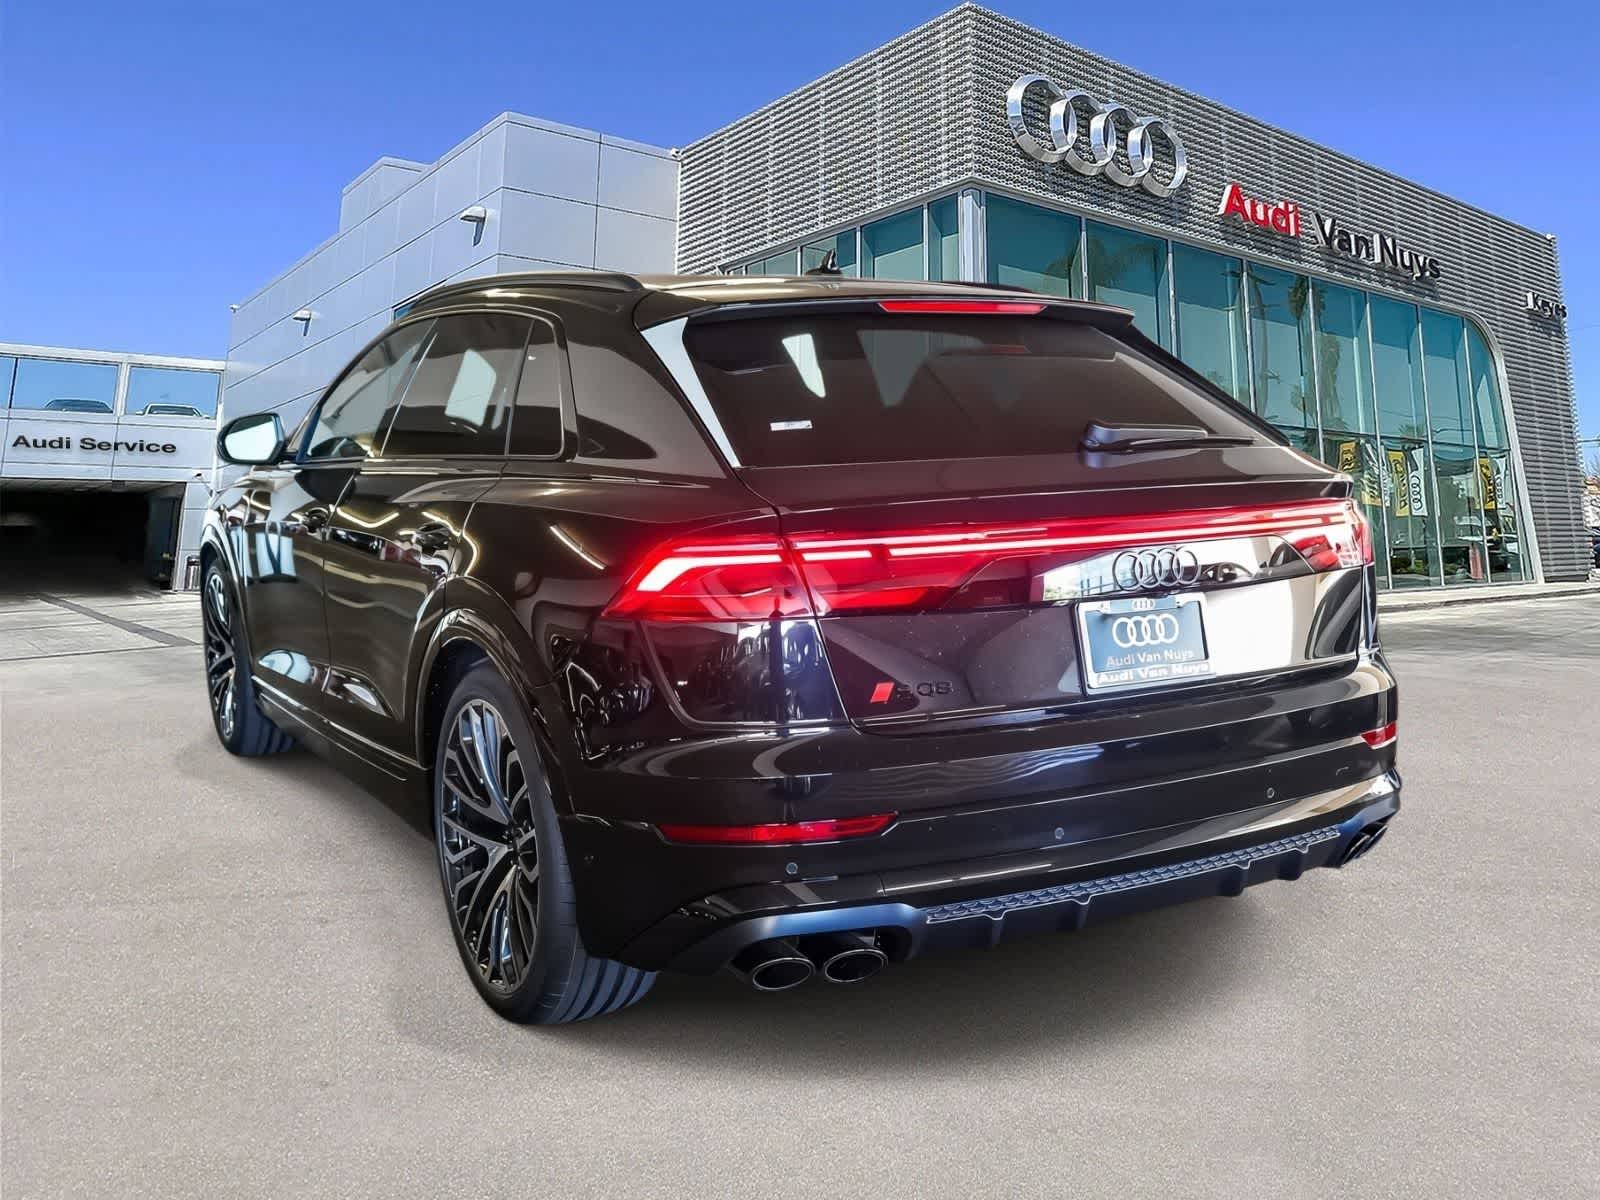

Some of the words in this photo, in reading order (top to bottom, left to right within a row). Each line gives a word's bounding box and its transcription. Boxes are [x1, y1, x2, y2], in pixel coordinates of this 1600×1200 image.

[1217, 183, 1303, 236] Audi
[1311, 213, 1371, 260] Van
[1373, 233, 1442, 281] Nuys
[1526, 290, 1568, 318] Keyes
[12, 435, 71, 450] Audi
[79, 437, 177, 454] Service
[1106, 653, 1136, 668] Audi
[1137, 650, 1164, 664] Van
[1165, 648, 1194, 662] Nuys
[1097, 669, 1133, 684] Audi
[1136, 665, 1169, 680] Van
[1173, 661, 1210, 675] Nuys
